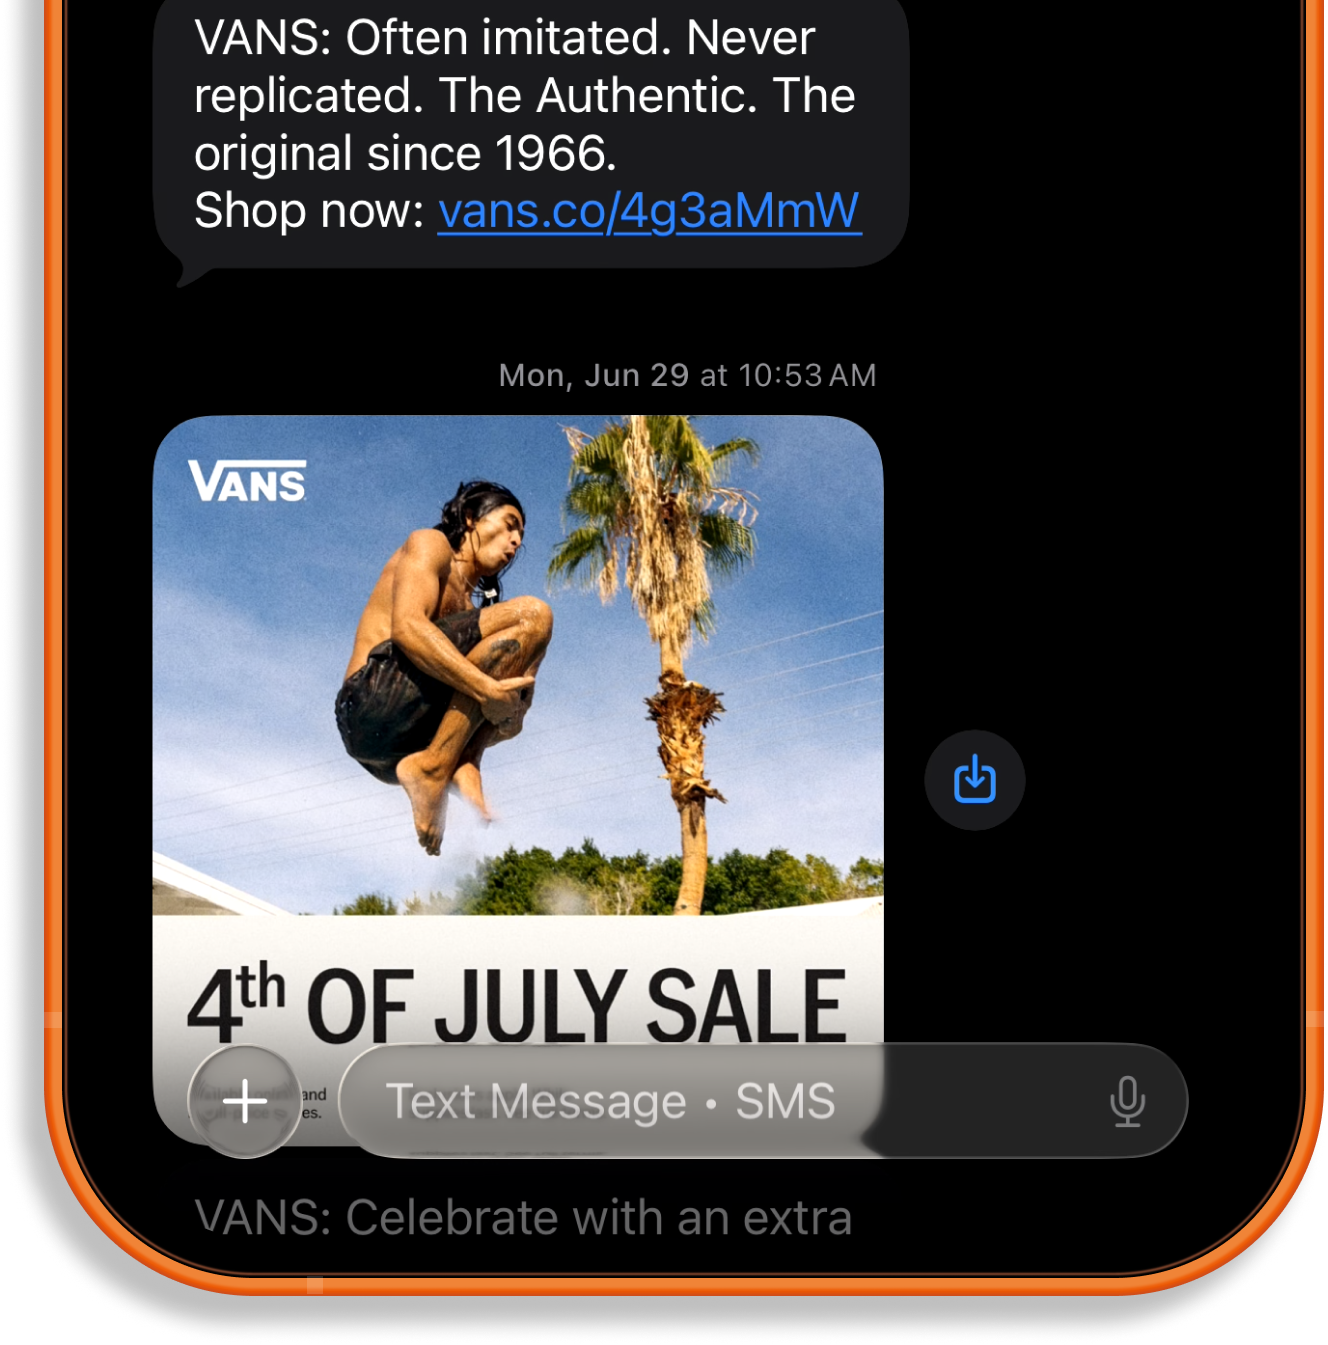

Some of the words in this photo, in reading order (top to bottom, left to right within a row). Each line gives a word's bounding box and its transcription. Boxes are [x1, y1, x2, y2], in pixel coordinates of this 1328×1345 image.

[195, 17, 330, 56] VANS:
[347, 17, 466, 56] Often
[484, 17, 671, 56] imitated.
[689, 18, 817, 56] Never
[197, 75, 422, 121] replicated.
[439, 75, 522, 114] The
[536, 75, 757, 114] Authentic.
[773, 75, 856, 114] The
[195, 133, 351, 180] original
[368, 133, 481, 172] since
[497, 133, 616, 172] 1966.
[196, 190, 306, 237] Shop
[323, 200, 423, 228] now:
[437, 190, 863, 237] vans.co/4g3aMmW
[500, 363, 572, 392] Mon,
[585, 363, 639, 387] Jun
[652, 363, 689, 387] 29
[701, 365, 728, 387] at
[740, 363, 822, 387] 10:53
[829, 364, 876, 387] AM
[187, 459, 307, 502] VANS
[187, 960, 285, 1043] 4th
[308, 968, 414, 1044] OF
[434, 969, 628, 1044] JULY
[647, 968, 847, 1044] SALE
[301, 1087, 327, 1101] and
[386, 1082, 475, 1119] Text
[493, 1082, 686, 1128] Message
[737, 1081, 835, 1119] SMS
[195, 1198, 330, 1236] VANS:
[347, 1197, 558, 1236] Celebrate
[572, 1196, 662, 1236] with
[679, 1207, 729, 1236] an
[745, 1200, 851, 1236] extra
